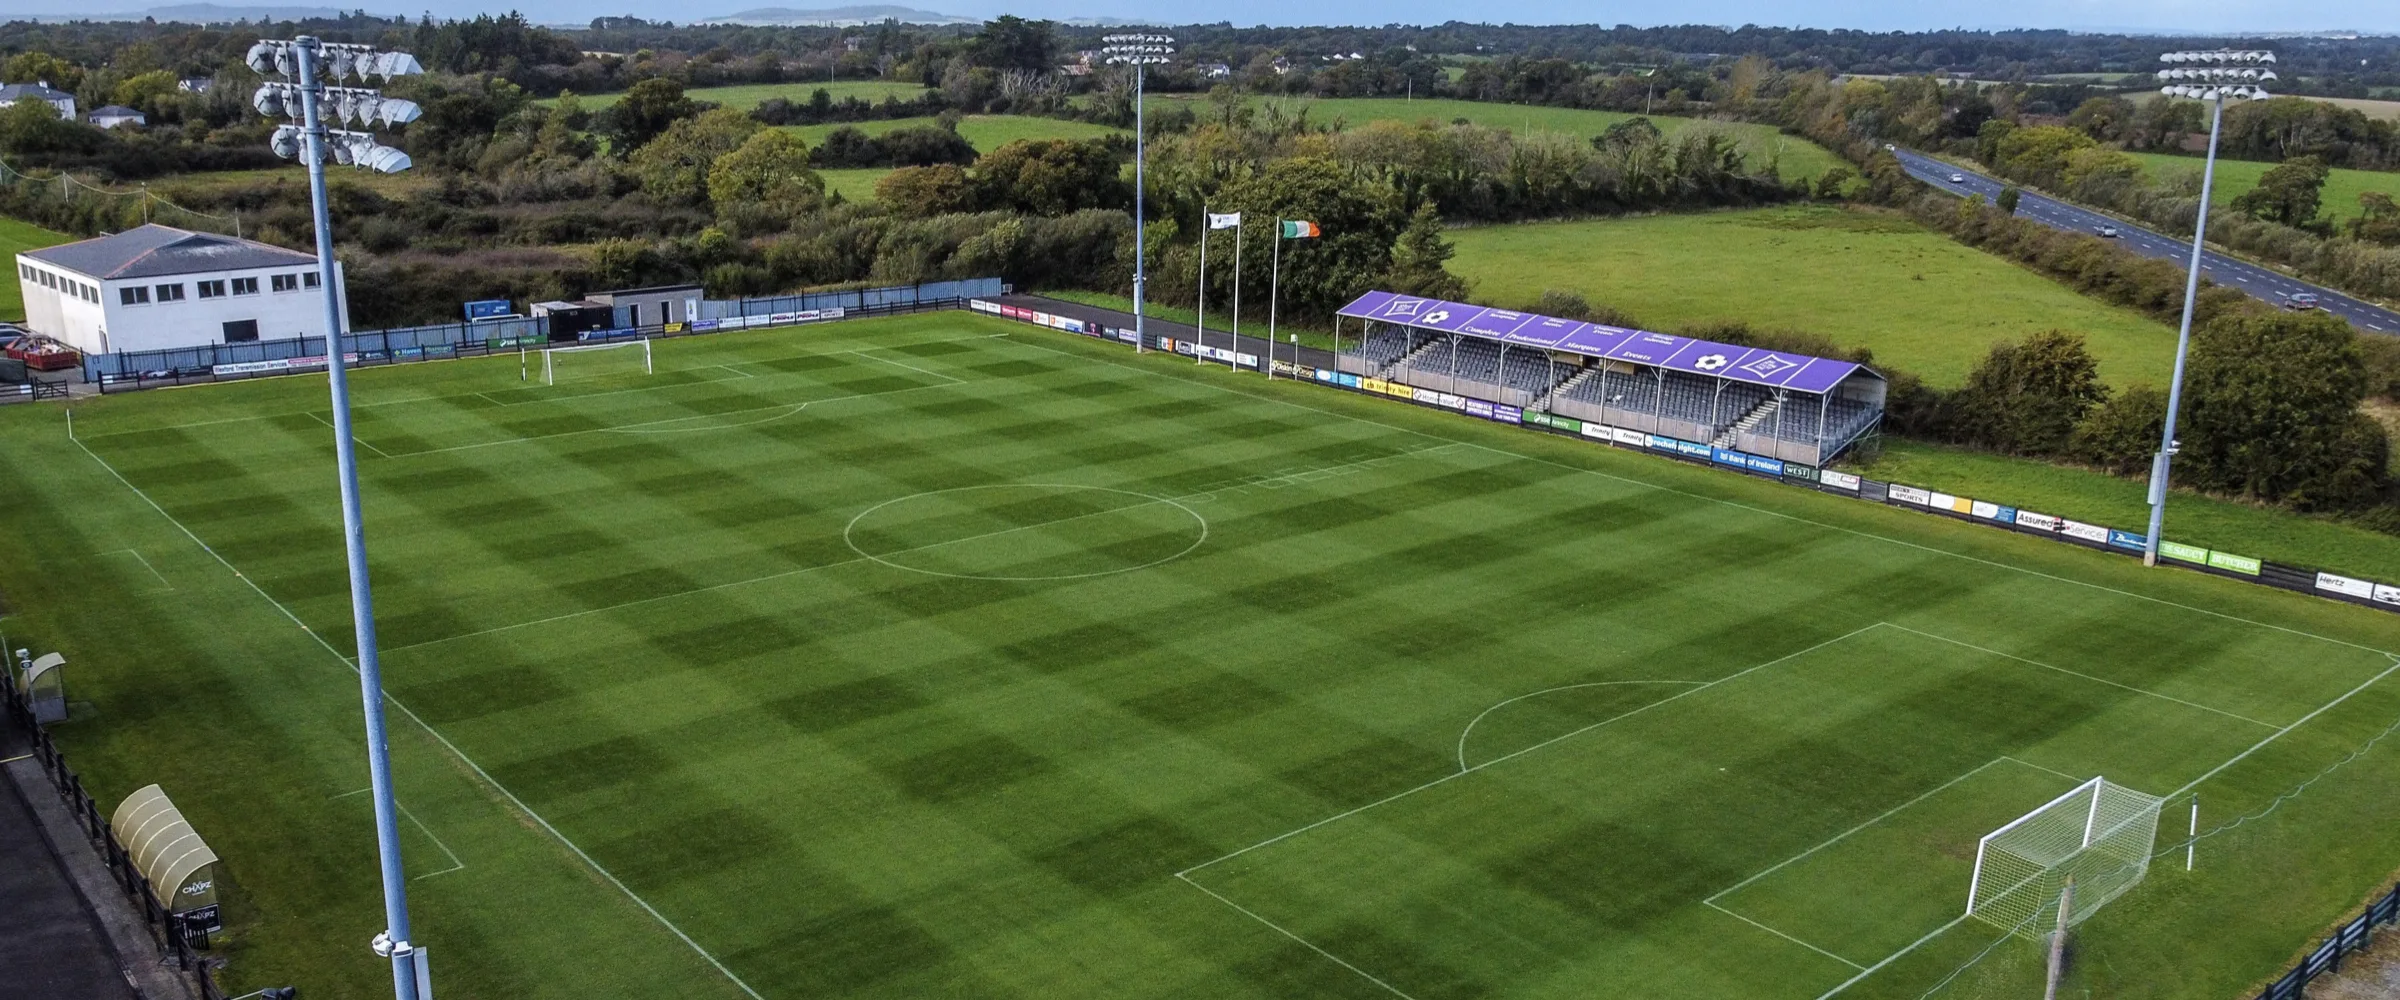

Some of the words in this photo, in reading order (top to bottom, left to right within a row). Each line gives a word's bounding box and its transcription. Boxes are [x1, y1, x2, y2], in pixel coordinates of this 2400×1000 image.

[1465, 325, 1501, 337] Complete
[1508, 333, 1556, 345] Professional
[1565, 342, 1601, 353] Marquee
[1622, 351, 1652, 361] Events
[1376, 384, 1396, 394] trinty
[1591, 426, 1611, 436] Trinity
[1622, 432, 1643, 442] Trinity
[1729, 452, 1746, 464] Bank
[1747, 458, 1755, 466] of
[1756, 460, 1780, 472] Ireland
[1787, 466, 1807, 476] WEST
[1895, 492, 1923, 502] SPORTS
[2018, 513, 2053, 528] Assured
[2070, 524, 2106, 540] Services
[2174, 546, 2205, 560] SAUCY
[2212, 554, 2257, 570] BUTCHER
[2319, 575, 2345, 587] Hertz
